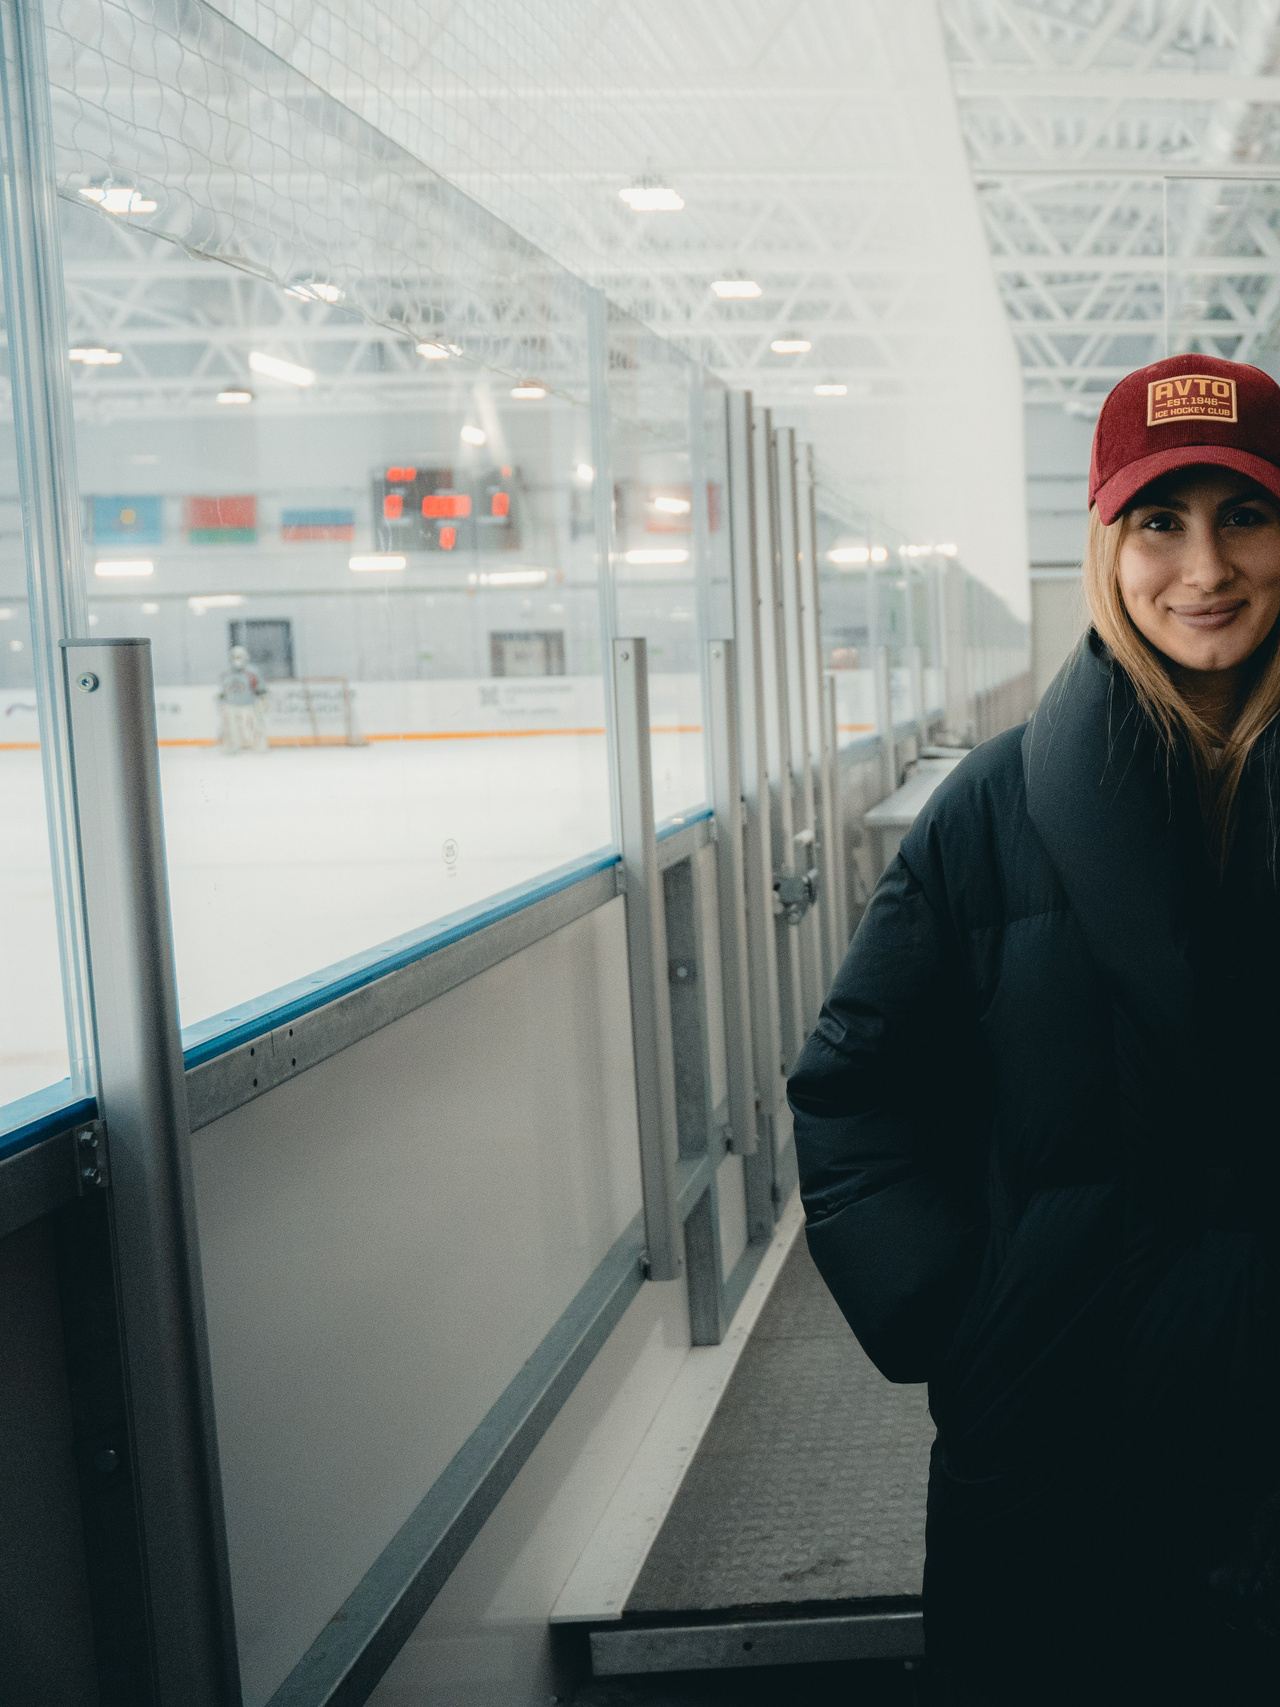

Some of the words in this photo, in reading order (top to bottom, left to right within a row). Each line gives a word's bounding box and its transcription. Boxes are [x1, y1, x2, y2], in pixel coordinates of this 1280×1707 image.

[1155, 379, 1230, 401] AVTO
[1155, 410, 1169, 419] ICE
[1170, 407, 1206, 416] HOCKEY
[1207, 407, 1231, 416] CLUB
